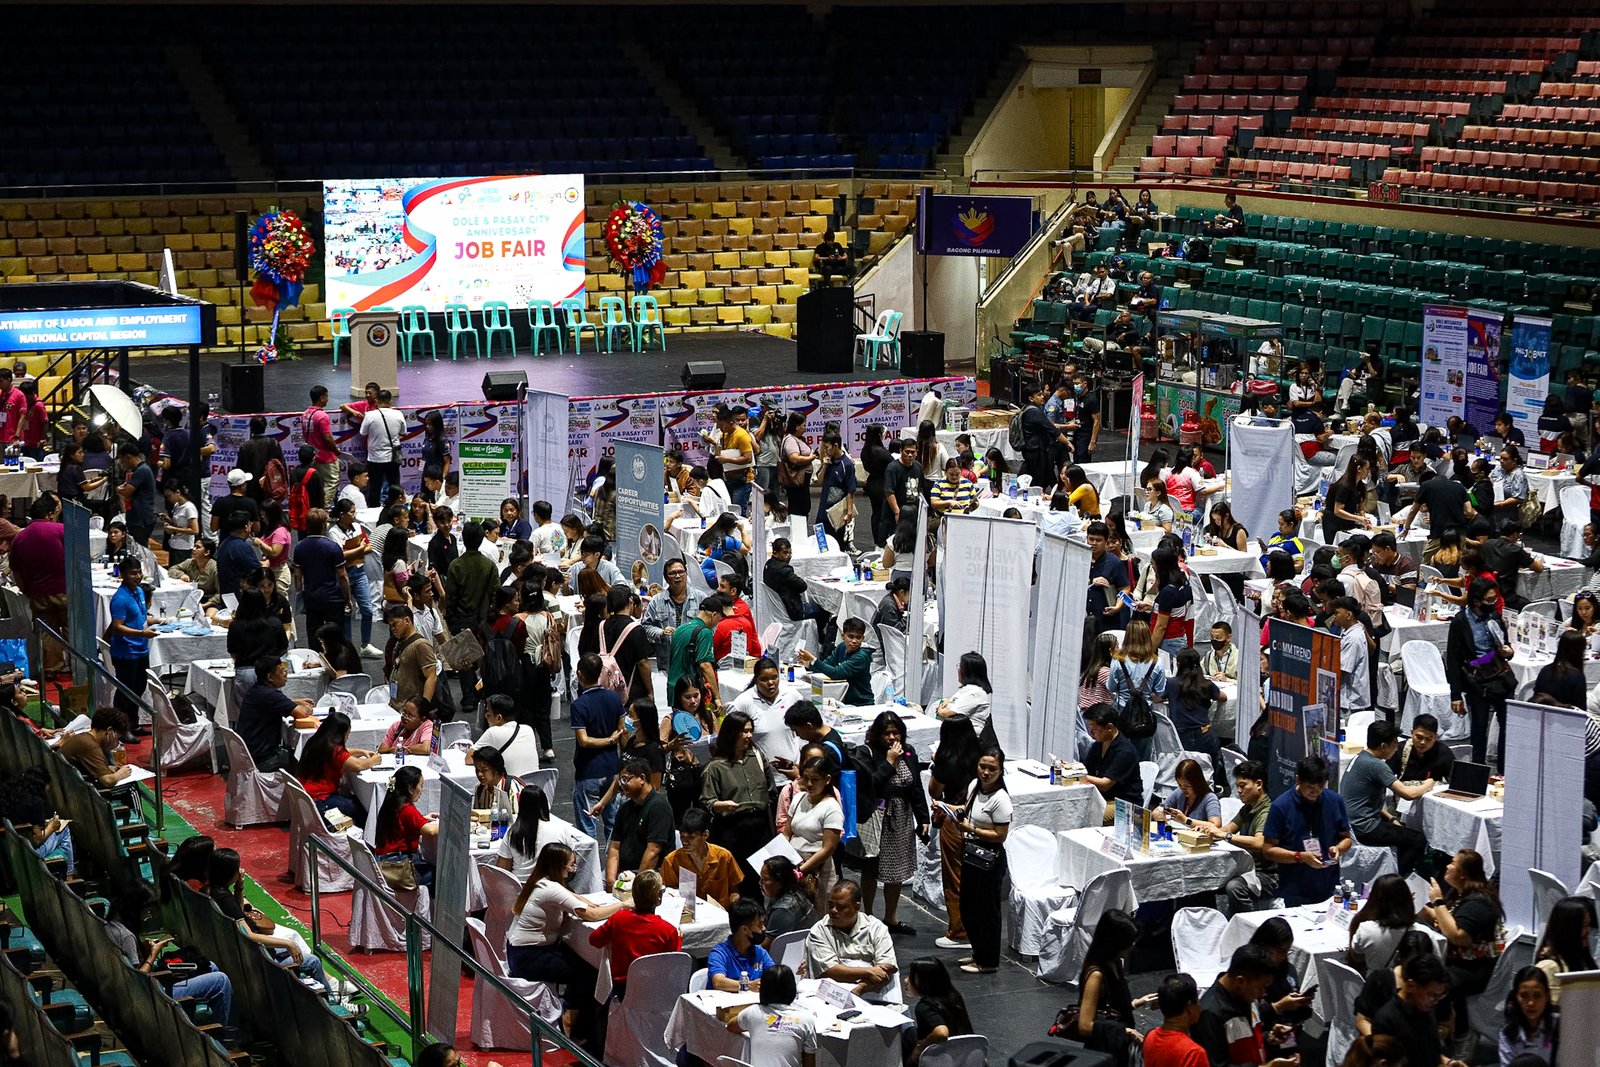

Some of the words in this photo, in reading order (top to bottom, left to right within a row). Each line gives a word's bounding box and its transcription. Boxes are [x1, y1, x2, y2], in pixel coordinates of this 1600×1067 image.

[452, 217, 480, 226] DOLE
[493, 216, 525, 224] PASAY
[529, 215, 550, 224] CITY
[466, 227, 538, 236] ANNIVERSARY
[454, 241, 494, 260] JOB
[502, 240, 546, 258] FAIR
[45, 318, 59, 328] OF
[60, 316, 94, 328] LABOR
[120, 312, 188, 325] EMPLOYMENT
[20, 334, 69, 344] NATIONAL
[70, 332, 110, 342] CAPITAL
[110, 329, 147, 339] REGION
[1478, 363, 1488, 376] FAIR
[1179, 400, 1194, 410] FOOD
[618, 488, 638, 498] CAREER
[618, 496, 659, 511] OPPORTUNITIES
